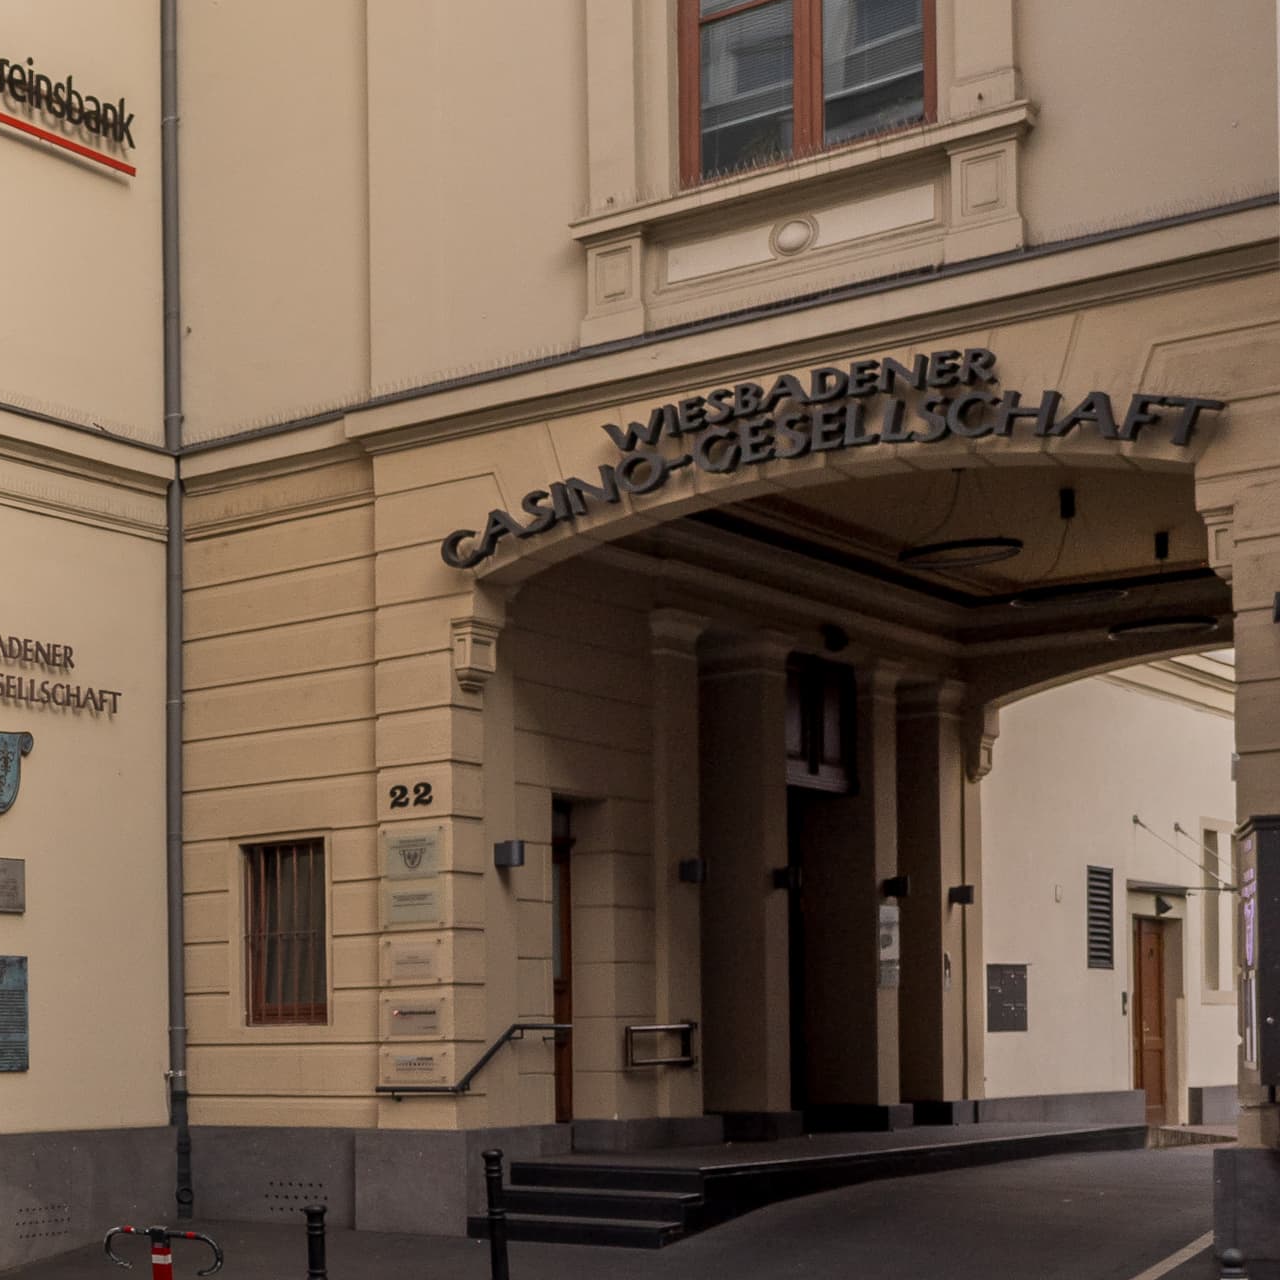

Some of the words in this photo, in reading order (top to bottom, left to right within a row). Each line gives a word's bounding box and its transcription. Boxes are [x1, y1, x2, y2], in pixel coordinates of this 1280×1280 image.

[601, 346, 999, 452] WIESBADENER
[440, 389, 1226, 570] CASINO-GESELLSCHAFT
[389, 781, 434, 810] 22
